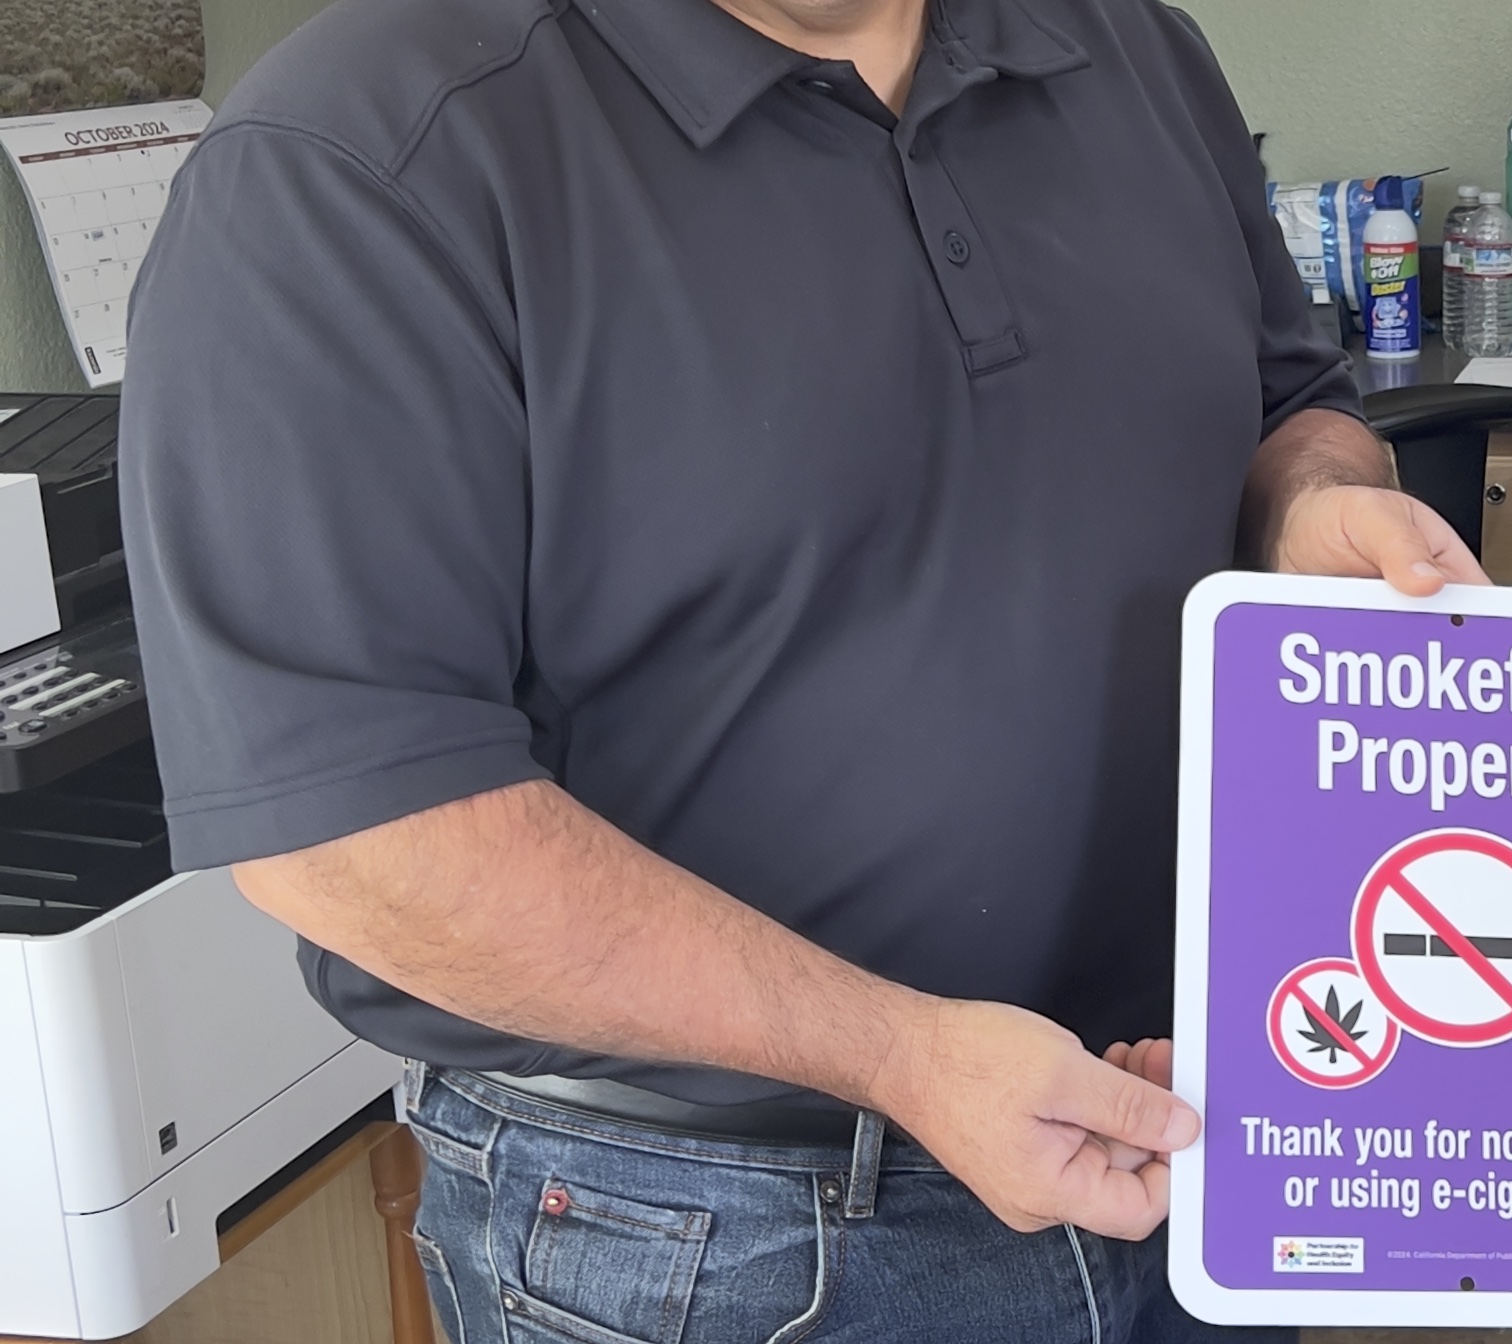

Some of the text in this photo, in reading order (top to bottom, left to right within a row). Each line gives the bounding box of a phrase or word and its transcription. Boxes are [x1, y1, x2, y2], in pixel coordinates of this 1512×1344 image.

[63, 126, 138, 146] OCTOBER
[135, 121, 170, 138] 2024
[1241, 1117, 1344, 1157] Thank
[1355, 1128, 1413, 1166] you
[1425, 1120, 1471, 1159] for
[1285, 1176, 1320, 1208] or
[1332, 1169, 1420, 1218] using
